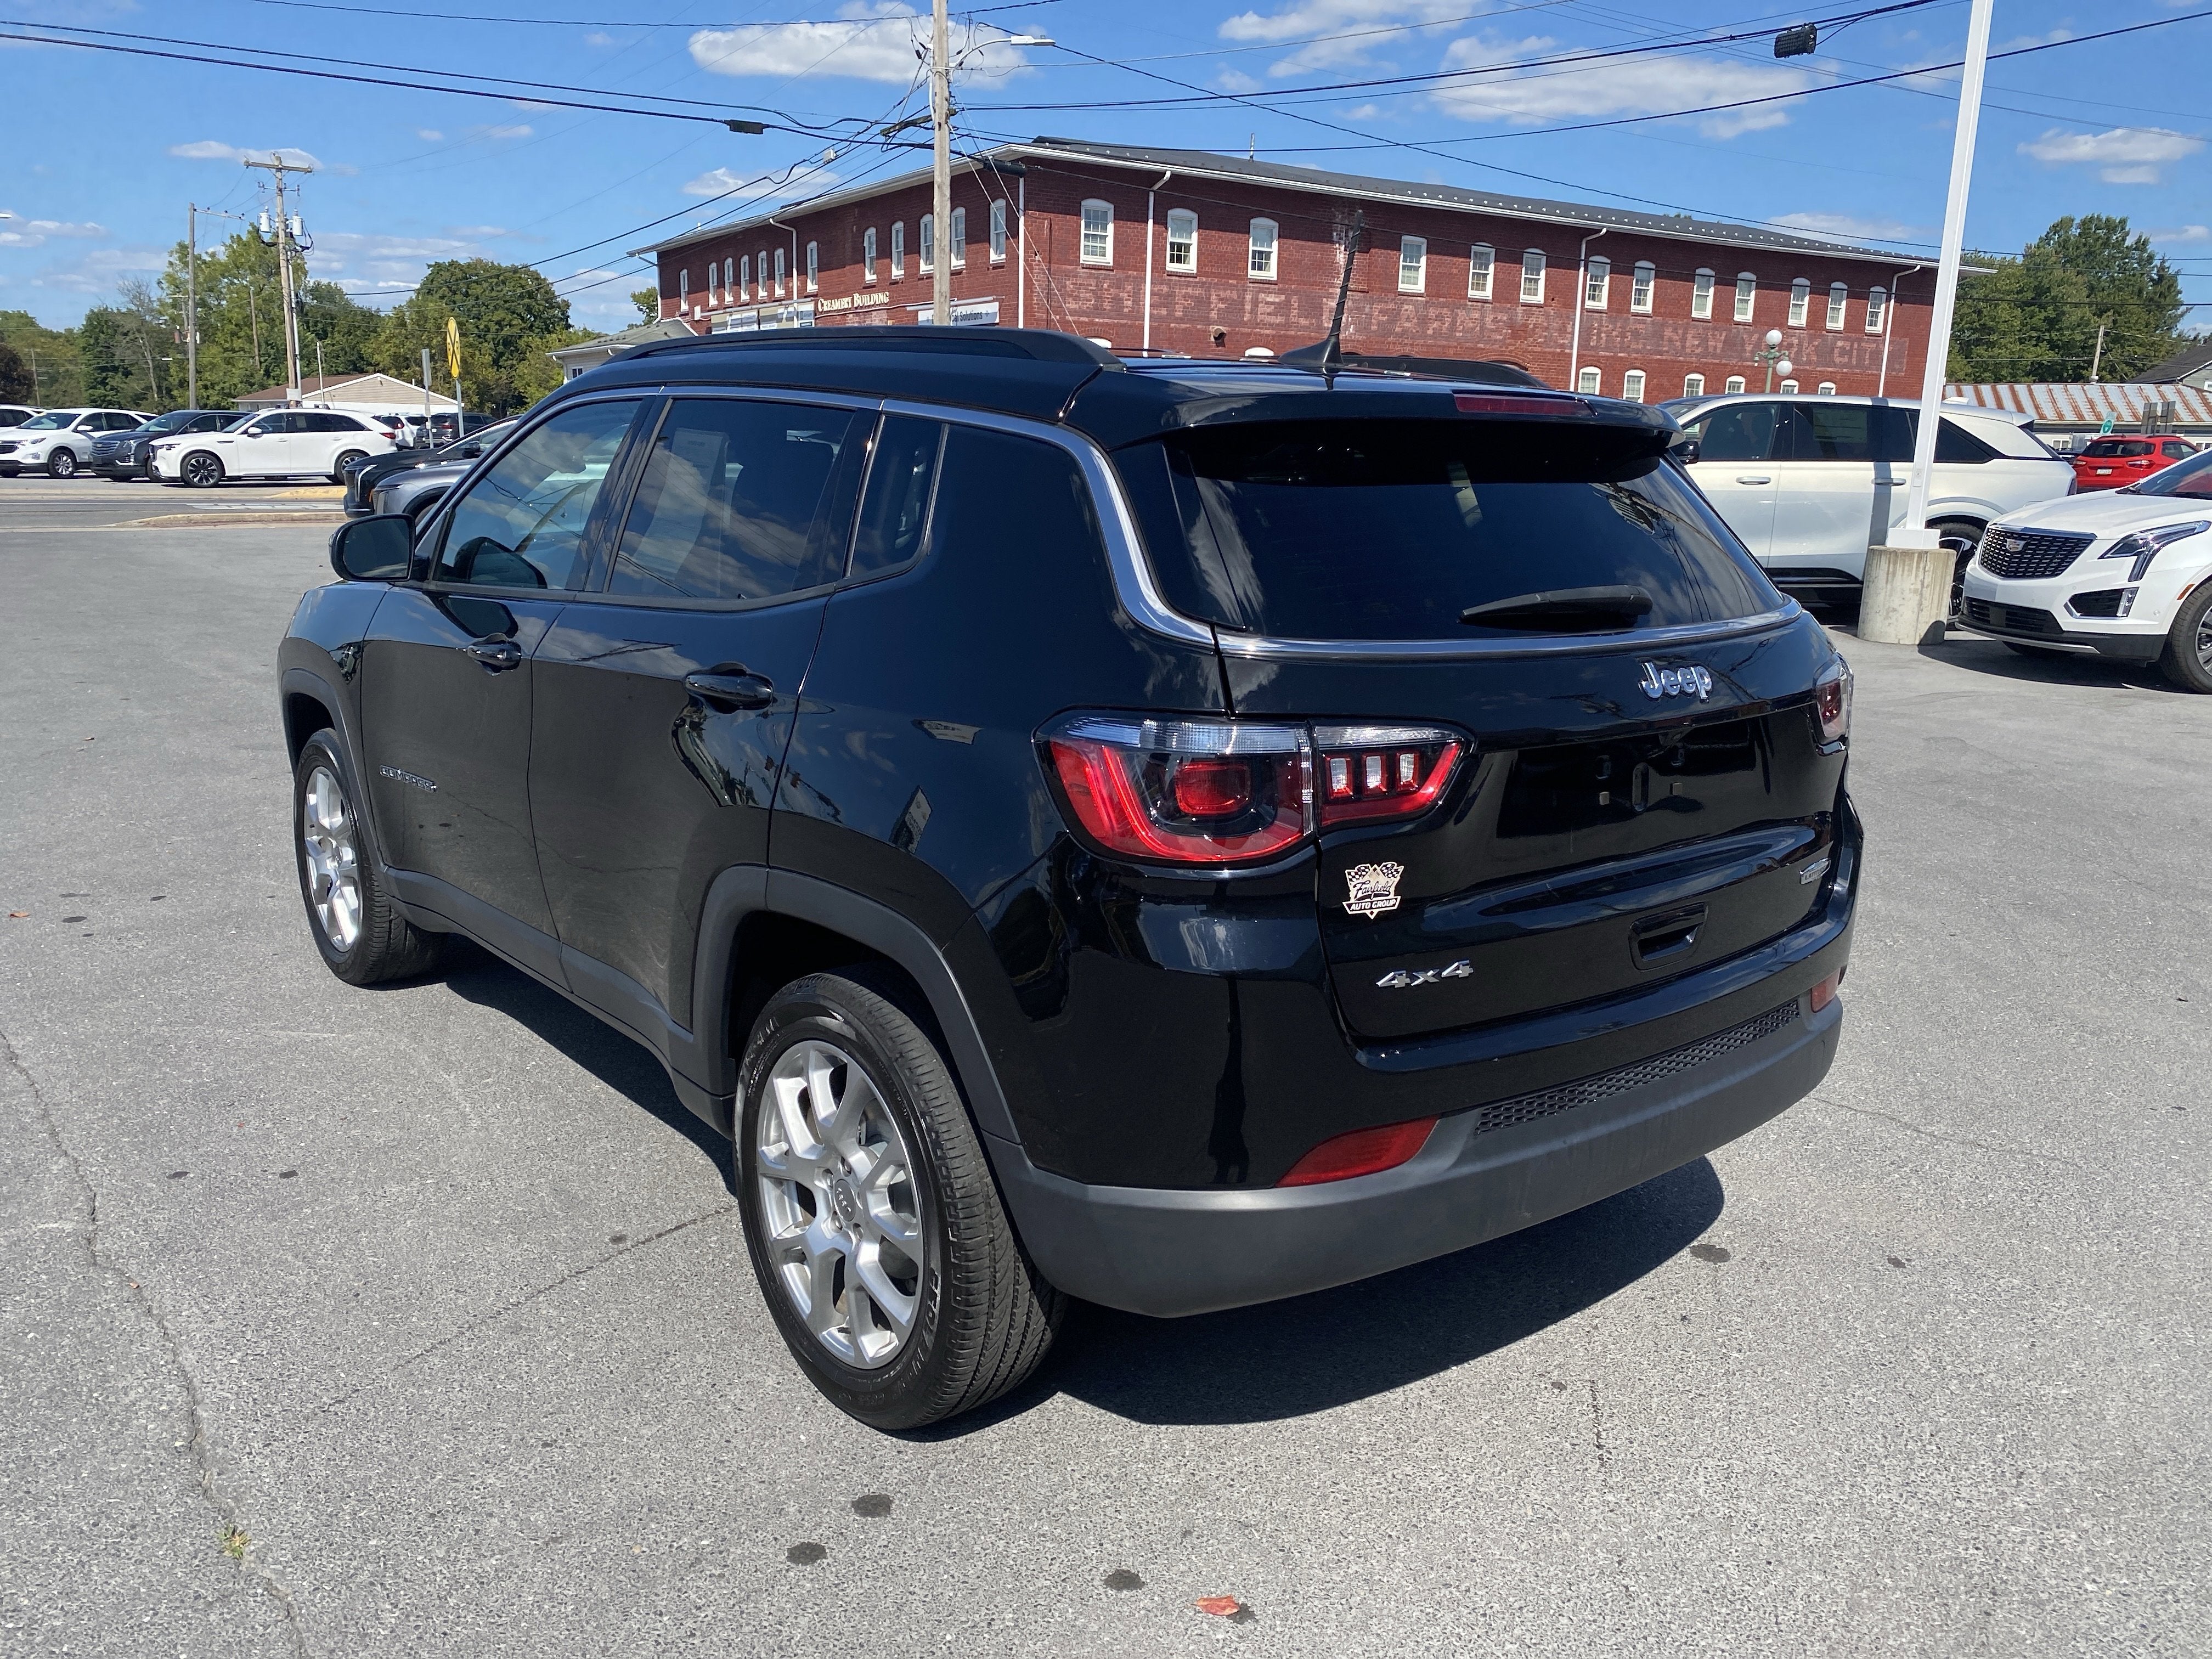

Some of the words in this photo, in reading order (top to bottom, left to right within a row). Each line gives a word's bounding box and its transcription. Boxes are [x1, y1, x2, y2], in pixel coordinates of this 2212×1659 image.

[818, 297, 852, 312] CREAMERY
[853, 291, 889, 307] BUILDING
[960, 310, 983, 321] Solutions
[1639, 662, 1712, 699] Jeep
[380, 765, 437, 793] COMPASS
[1353, 880, 1395, 900] Fairfield
[1350, 902, 1371, 911] AUTO
[1372, 899, 1396, 909] GROUP
